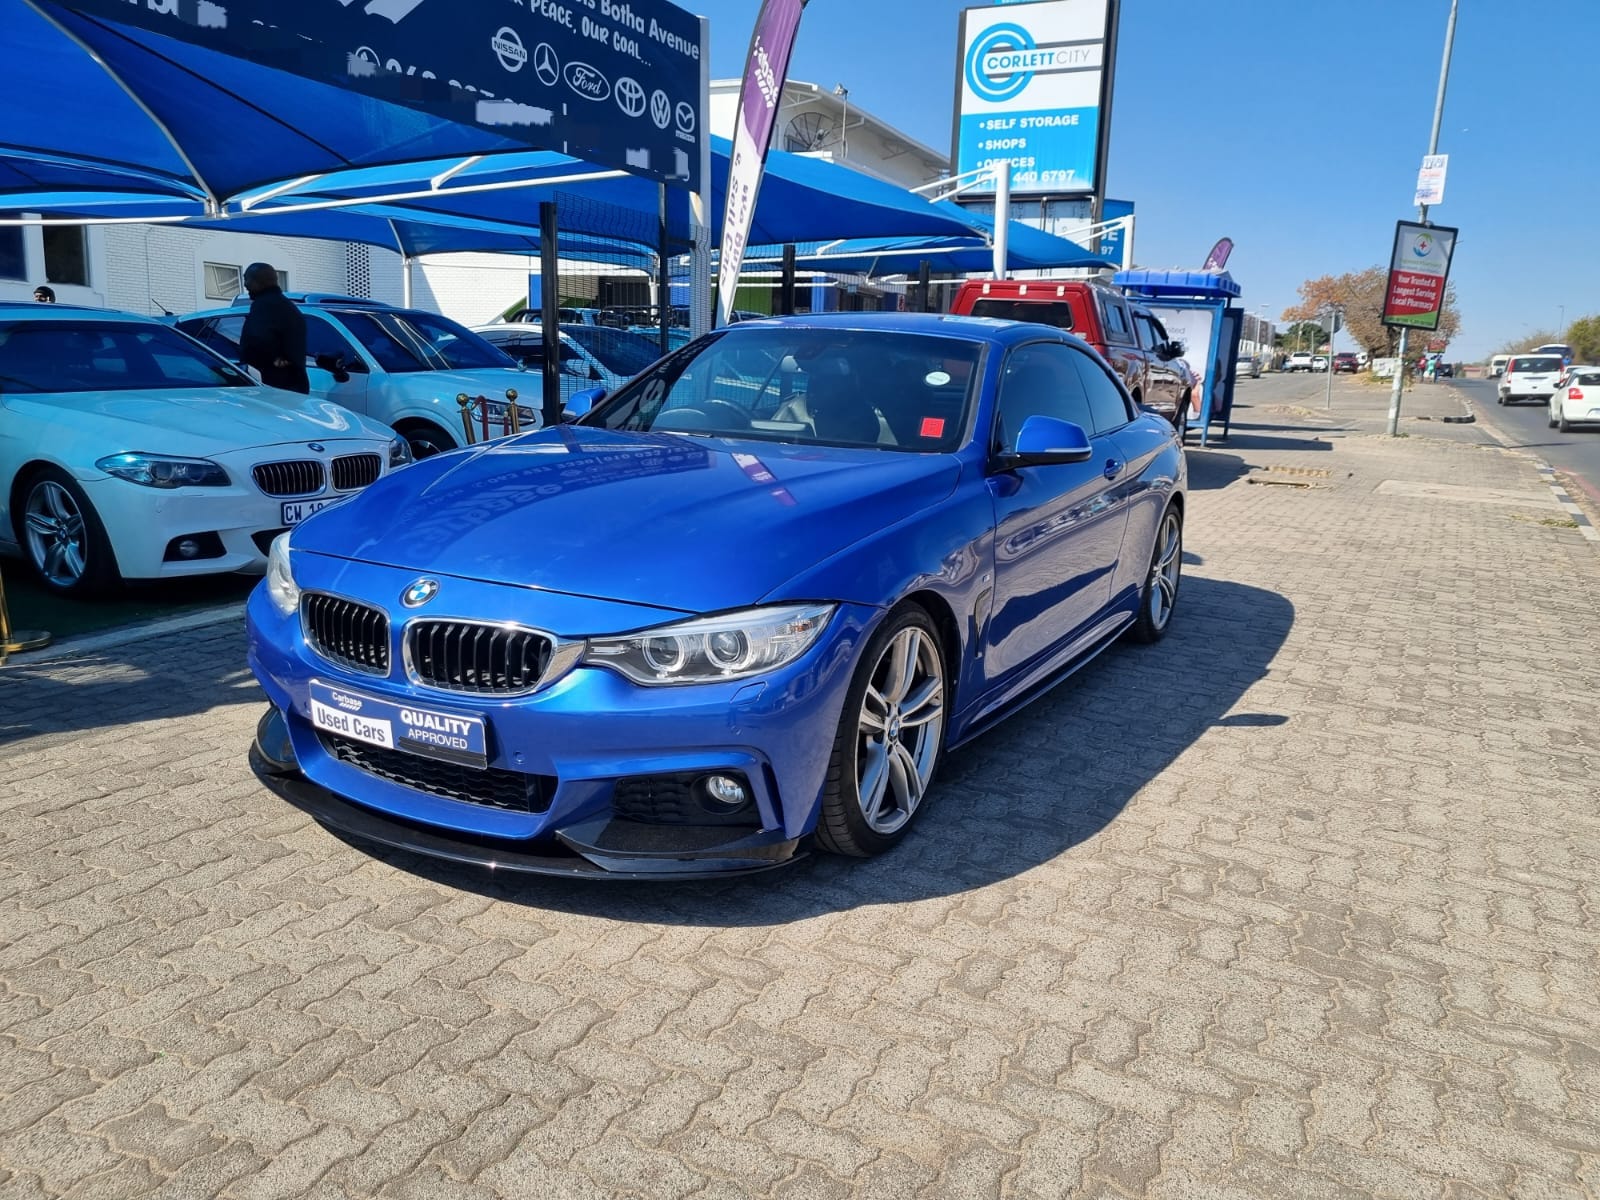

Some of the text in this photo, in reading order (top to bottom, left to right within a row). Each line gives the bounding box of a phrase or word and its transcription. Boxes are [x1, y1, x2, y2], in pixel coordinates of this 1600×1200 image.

[601, 0, 699, 60] Botha Avenue
[494, 40, 526, 60] NISSAN
[573, 67, 602, 94] Ford
[986, 115, 1079, 130] SELF STORAGE
[985, 138, 1026, 150] SHOPS
[984, 157, 1035, 168] OFFCES
[1012, 171, 1037, 183] 440
[1041, 170, 1075, 182] 6797
[1411, 276, 1431, 287] Trusted
[1393, 285, 1436, 300] Longest Serving
[1391, 296, 1433, 311] Local Pharmacy
[286, 504, 302, 522] CW
[332, 692, 362, 707] Carbase
[317, 707, 385, 742] Used Cars
[400, 710, 471, 736] QUALITY
[408, 728, 467, 750] APPROVED
